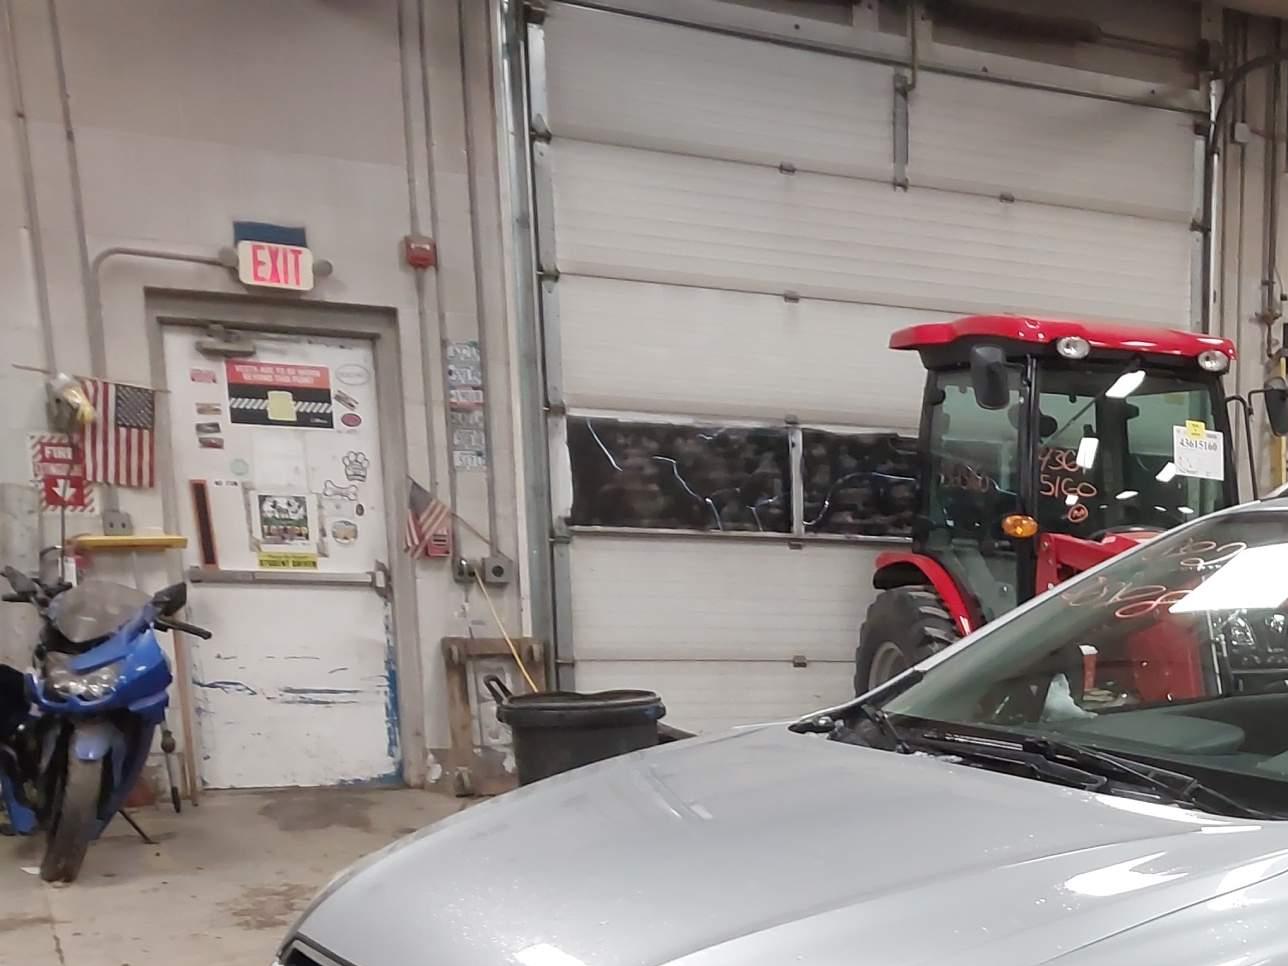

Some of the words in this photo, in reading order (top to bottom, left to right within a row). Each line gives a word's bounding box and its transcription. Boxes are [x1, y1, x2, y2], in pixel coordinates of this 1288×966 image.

[251, 244, 302, 286] EXIT
[1179, 438, 1218, 452] 43615160
[1038, 448, 1087, 476] 436
